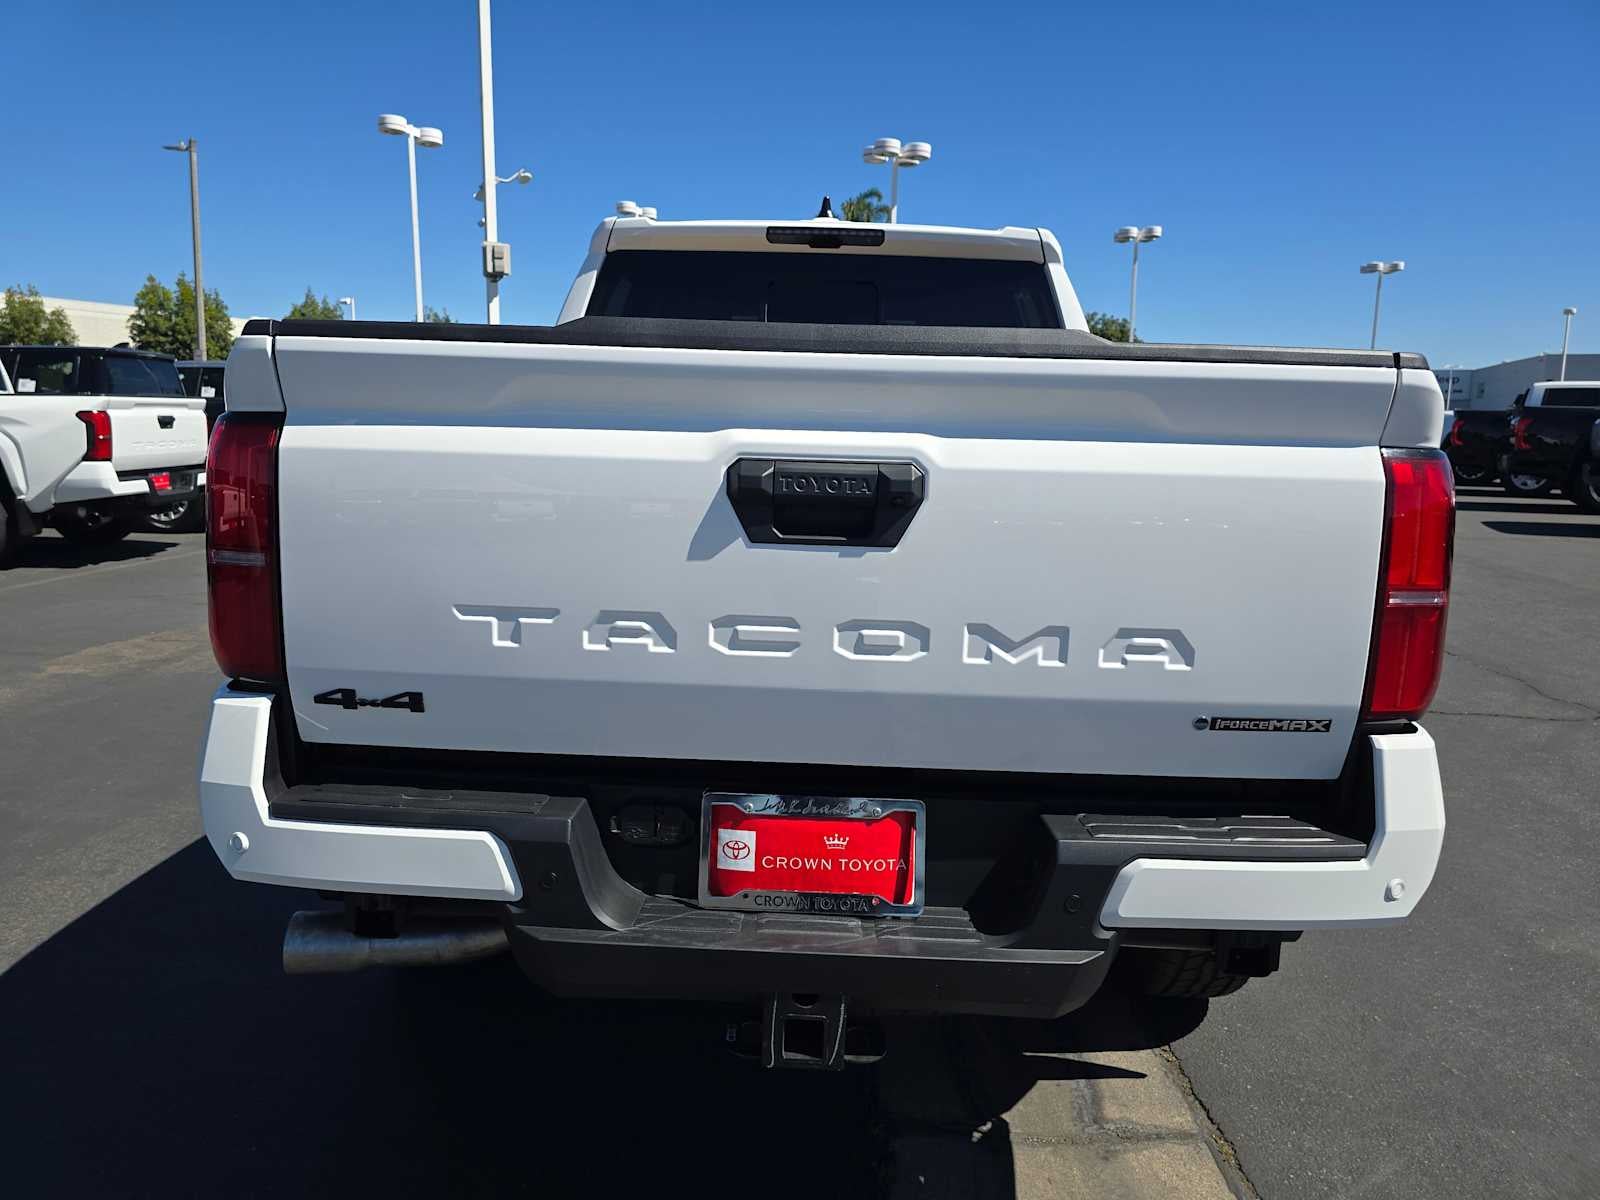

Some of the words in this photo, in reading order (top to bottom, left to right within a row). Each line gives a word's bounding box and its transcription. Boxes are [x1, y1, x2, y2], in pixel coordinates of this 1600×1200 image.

[779, 476, 873, 495] TOYOTA
[452, 603, 1196, 672] TACOMA
[762, 855, 832, 871] CROWN
[839, 858, 908, 872] TOYOTA
[754, 894, 811, 910] CROWN
[814, 897, 869, 912] TOYOTA
